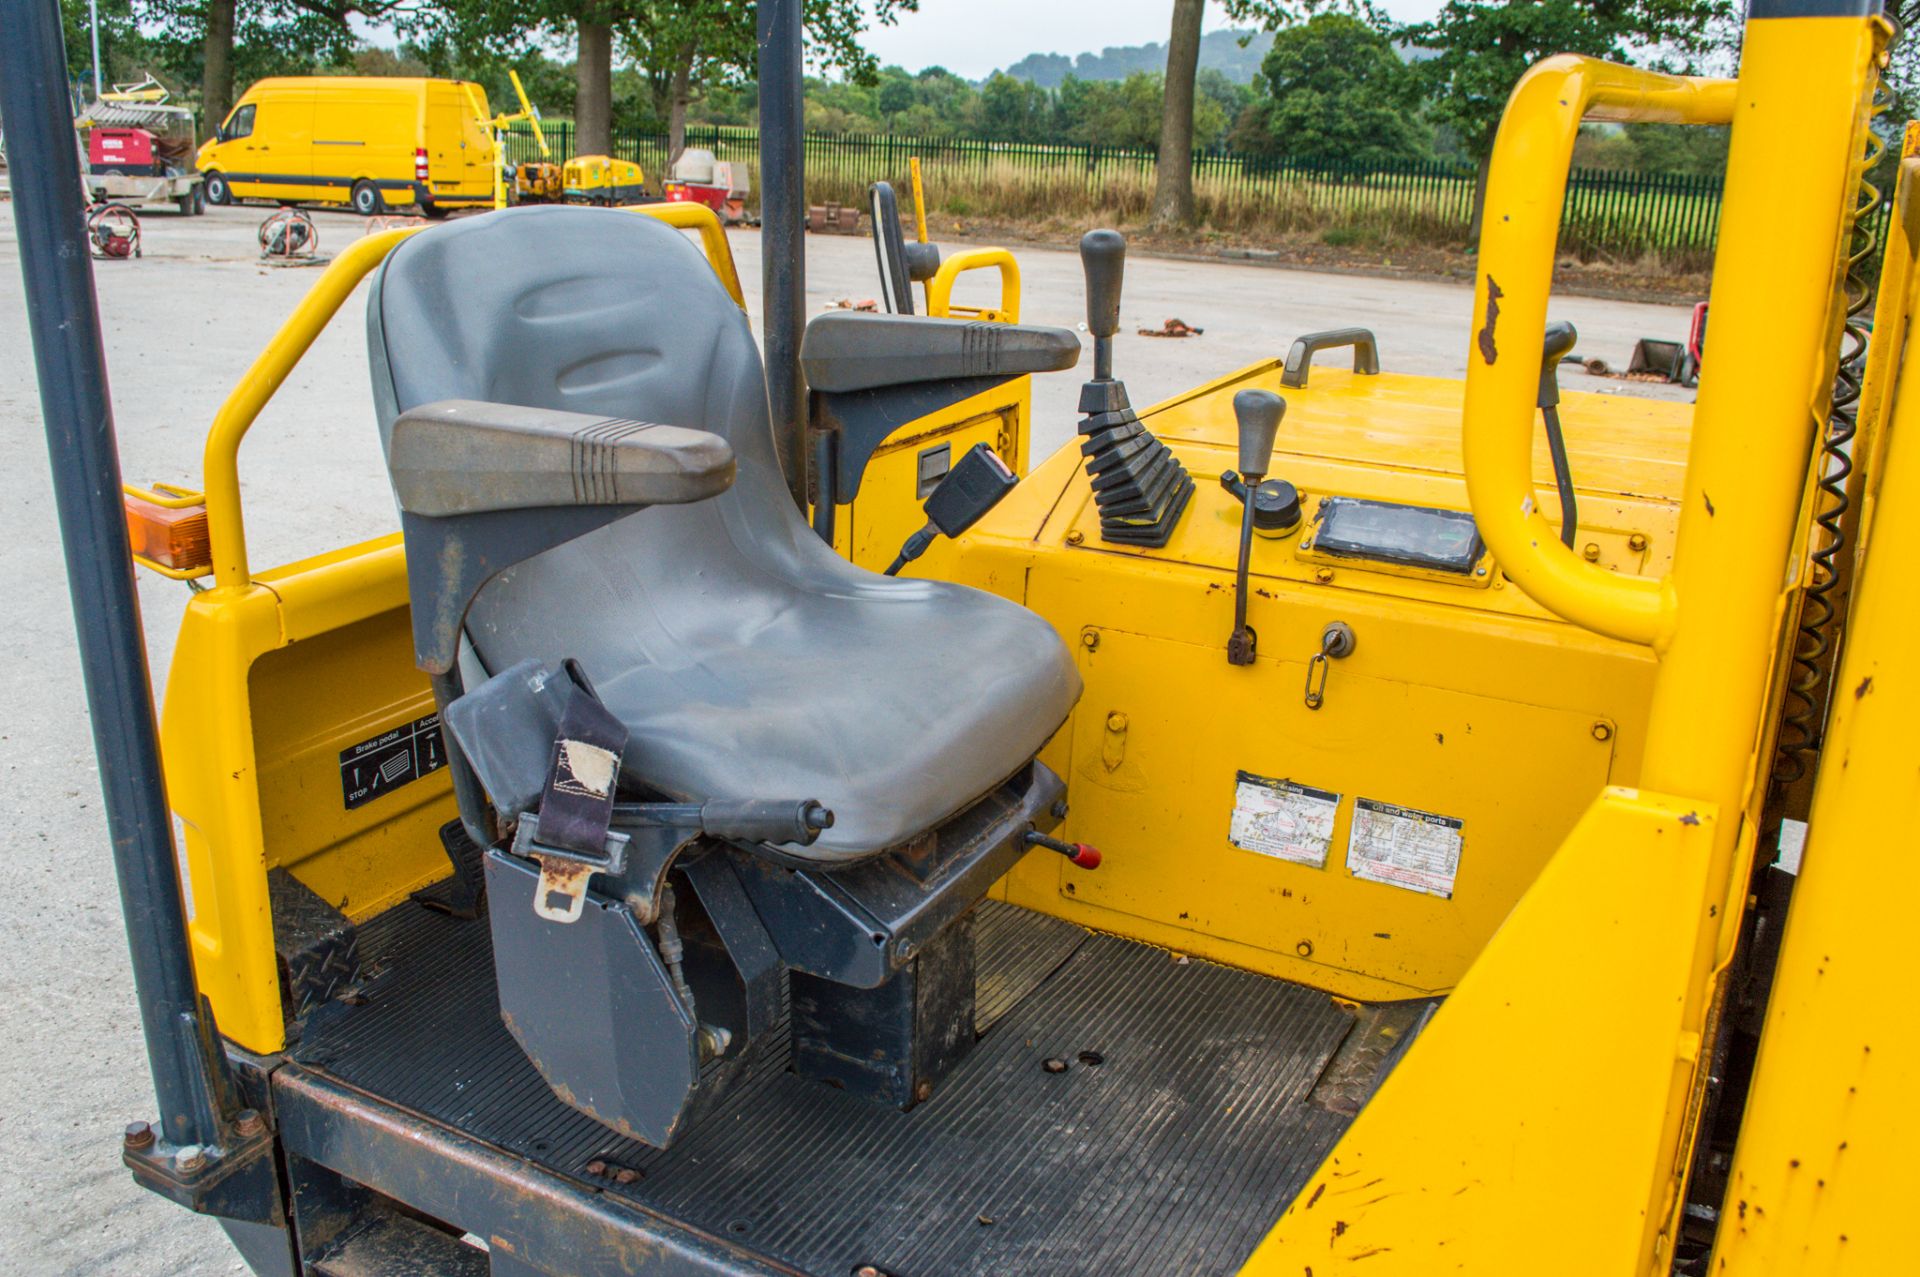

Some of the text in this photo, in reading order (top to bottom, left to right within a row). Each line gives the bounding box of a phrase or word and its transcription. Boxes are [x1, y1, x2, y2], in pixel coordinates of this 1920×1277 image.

[355, 730, 400, 754] Brake pedal
[348, 787, 368, 801] STOP
[1372, 802, 1384, 812] Oil
[1385, 805, 1400, 815] and
[1425, 814, 1447, 827] ports
